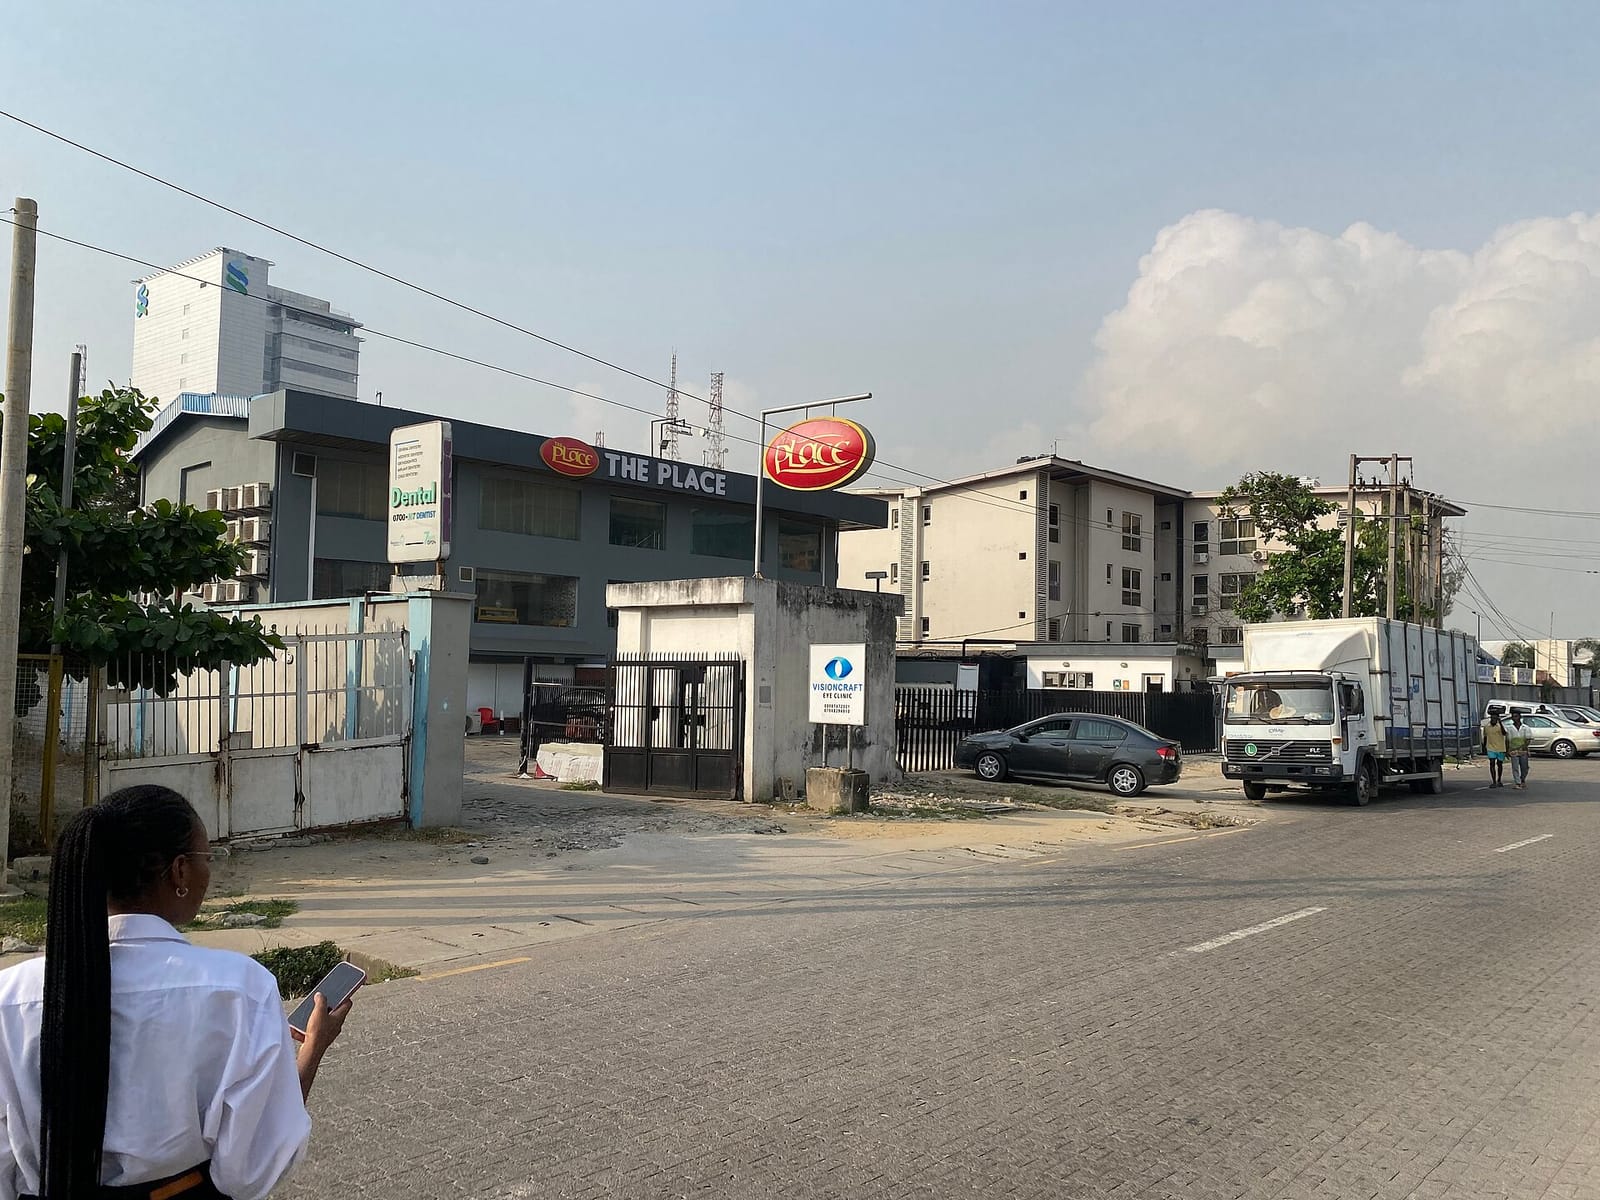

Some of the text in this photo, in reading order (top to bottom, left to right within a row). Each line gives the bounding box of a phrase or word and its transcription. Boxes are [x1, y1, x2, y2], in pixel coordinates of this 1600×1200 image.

[605, 452, 726, 495] THE PLACE
[391, 481, 437, 508] Dental
[812, 683, 863, 692] VISIONCRAFT
